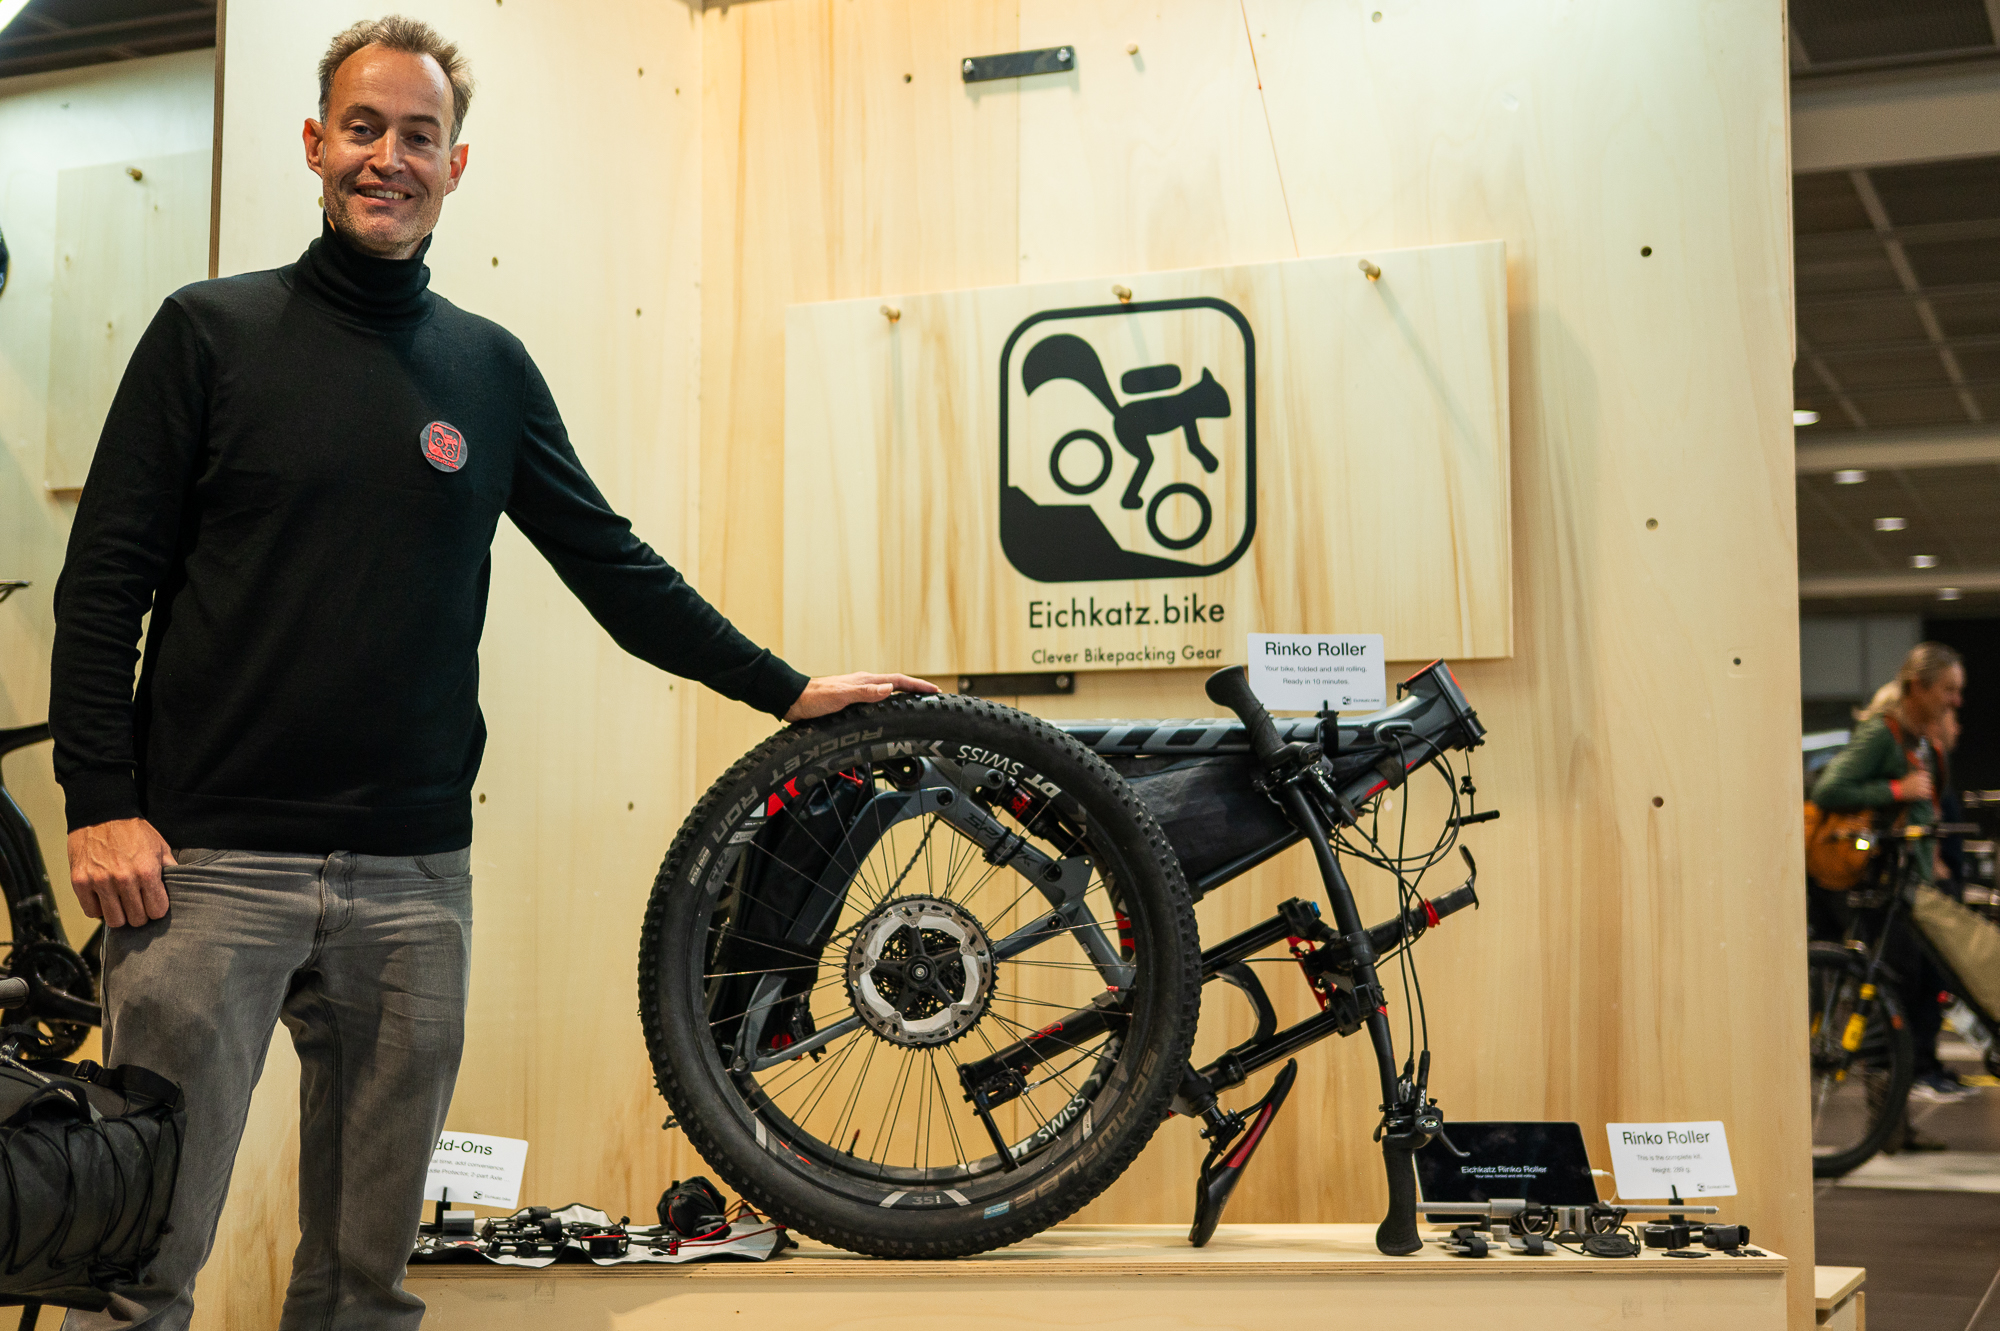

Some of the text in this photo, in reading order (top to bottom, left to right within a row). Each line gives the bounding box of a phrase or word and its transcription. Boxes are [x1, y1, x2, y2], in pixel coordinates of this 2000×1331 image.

[1029, 593, 1225, 628] Eichkatz.bike
[1031, 645, 1222, 666] Clever Bikepacking Gear
[1264, 641, 1367, 656] Rinko Roller
[1280, 665, 1296, 673] bike,
[1346, 666, 1368, 674] rolling.
[956, 744, 1062, 800] DT SWISS
[711, 726, 883, 844] ROCKET RON
[1036, 1093, 1086, 1140] SWISS
[1015, 1050, 1158, 1209] SCHWALBE
[1622, 1130, 1710, 1145] Rinko Roller
[435, 1139, 493, 1155] dd-Ons
[1461, 1165, 1548, 1174] Eichkatz Rinko Roller
